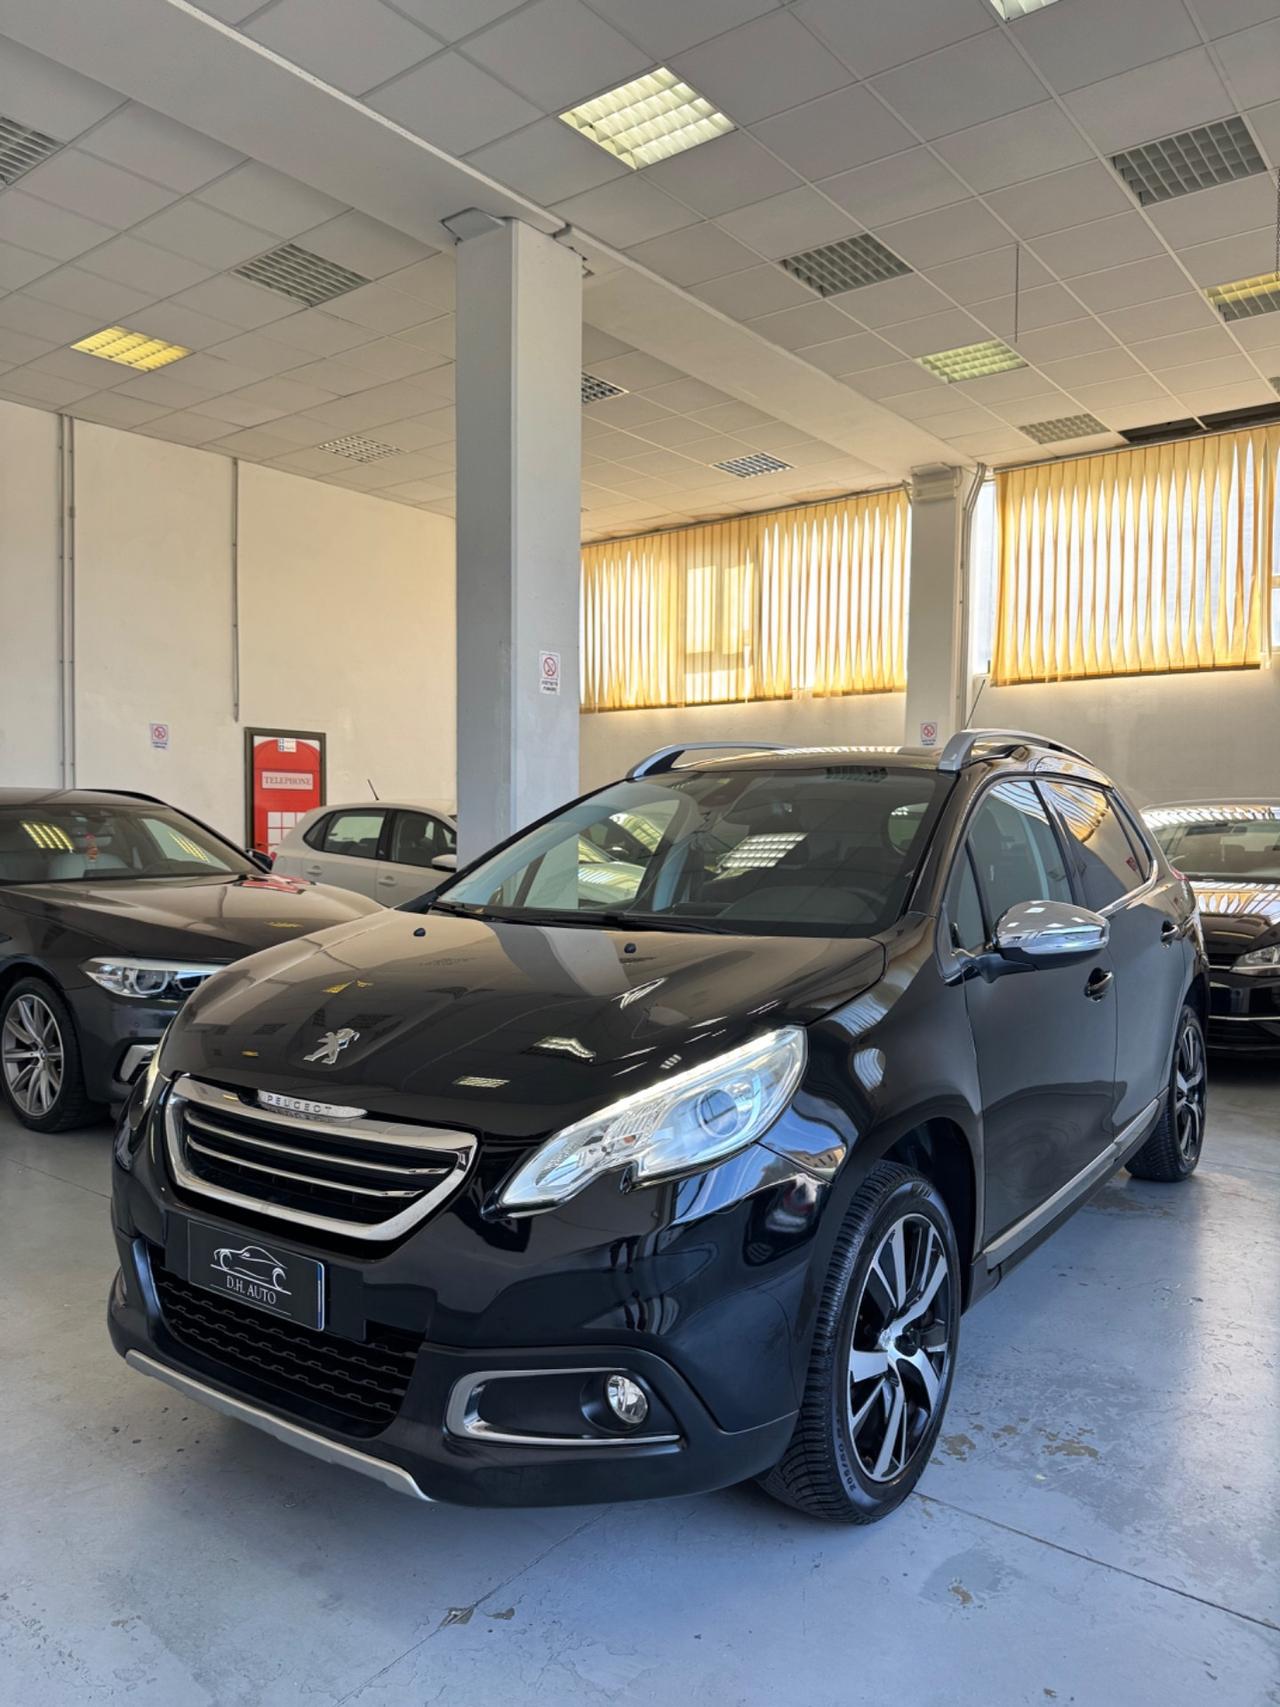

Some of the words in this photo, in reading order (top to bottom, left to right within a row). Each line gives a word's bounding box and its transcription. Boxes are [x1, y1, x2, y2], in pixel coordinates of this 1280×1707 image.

[264, 776, 312, 785] TELEPHONE
[267, 1094, 332, 1113] PEUGEOT
[247, 1285, 277, 1304] AUTO
